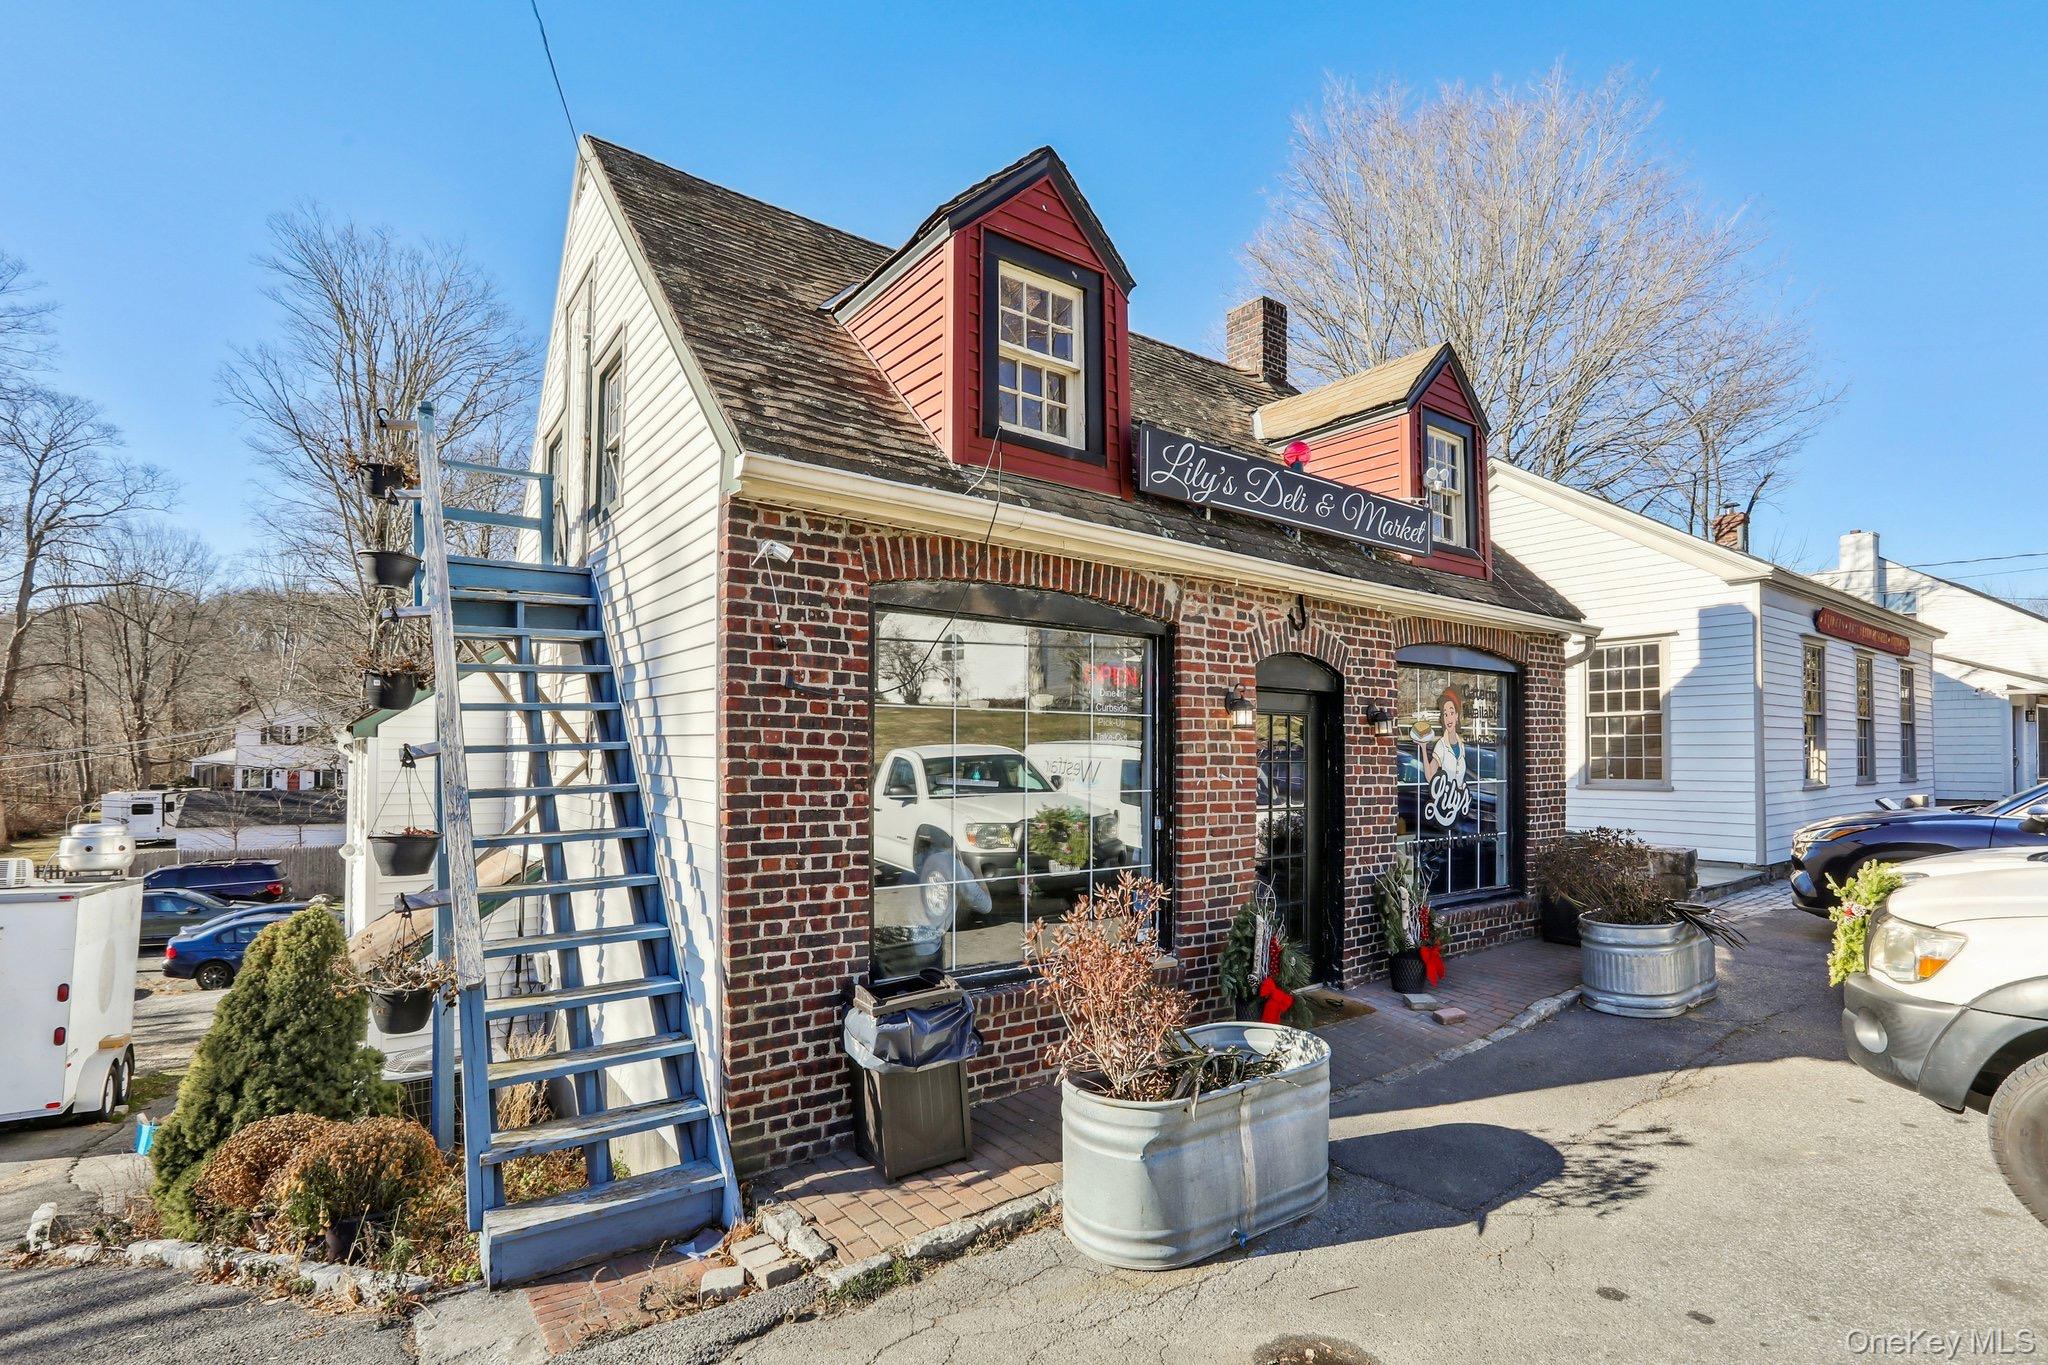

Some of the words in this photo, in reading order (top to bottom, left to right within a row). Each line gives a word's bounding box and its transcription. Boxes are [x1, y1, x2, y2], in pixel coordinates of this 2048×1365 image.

[1151, 442, 1238, 503] Lily's
[1246, 467, 1309, 514] Deli
[1315, 493, 1336, 518] &
[1342, 492, 1428, 545] Market
[1083, 663, 1138, 688] OPEN
[1095, 703, 1128, 713] Curbside
[1097, 718, 1126, 728] Pick-Up
[1425, 774, 1472, 827] Lily's
